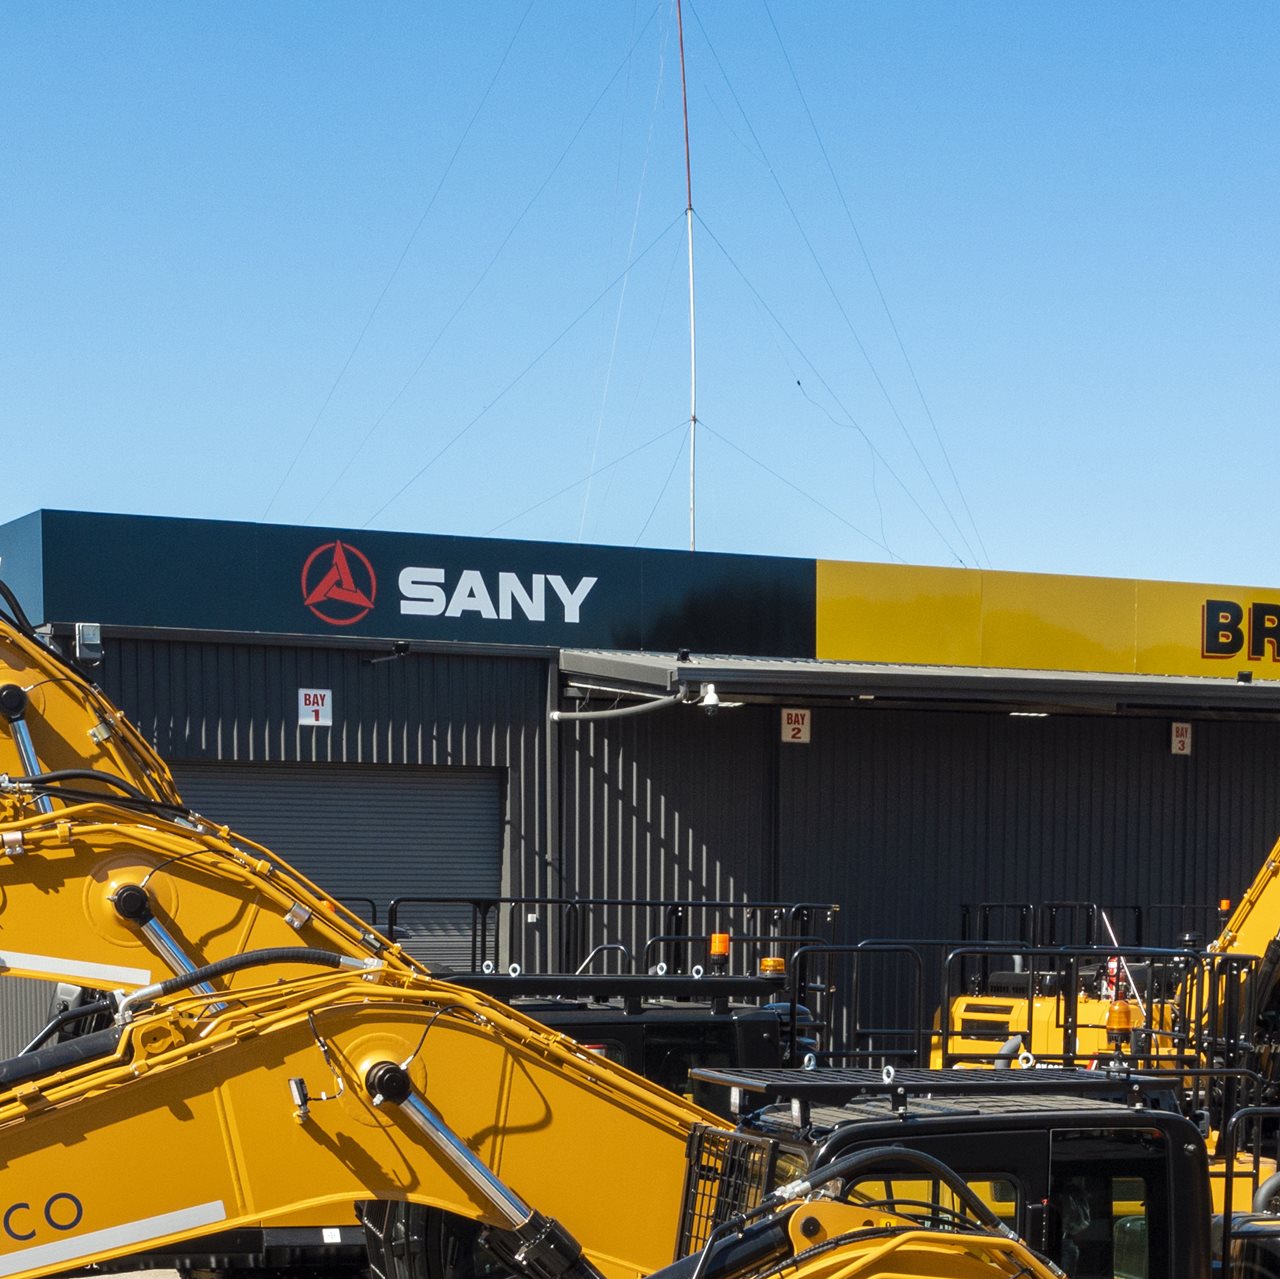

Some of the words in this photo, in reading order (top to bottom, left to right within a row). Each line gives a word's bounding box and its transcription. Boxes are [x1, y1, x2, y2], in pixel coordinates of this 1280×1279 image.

[398, 566, 598, 623] SANY
[304, 693, 326, 707] BAY
[311, 709, 320, 722] 1
[786, 713, 806, 725] BAY
[791, 727, 802, 739] 2
[1175, 726, 1189, 739] BAY
[1178, 740, 1185, 751] 3
